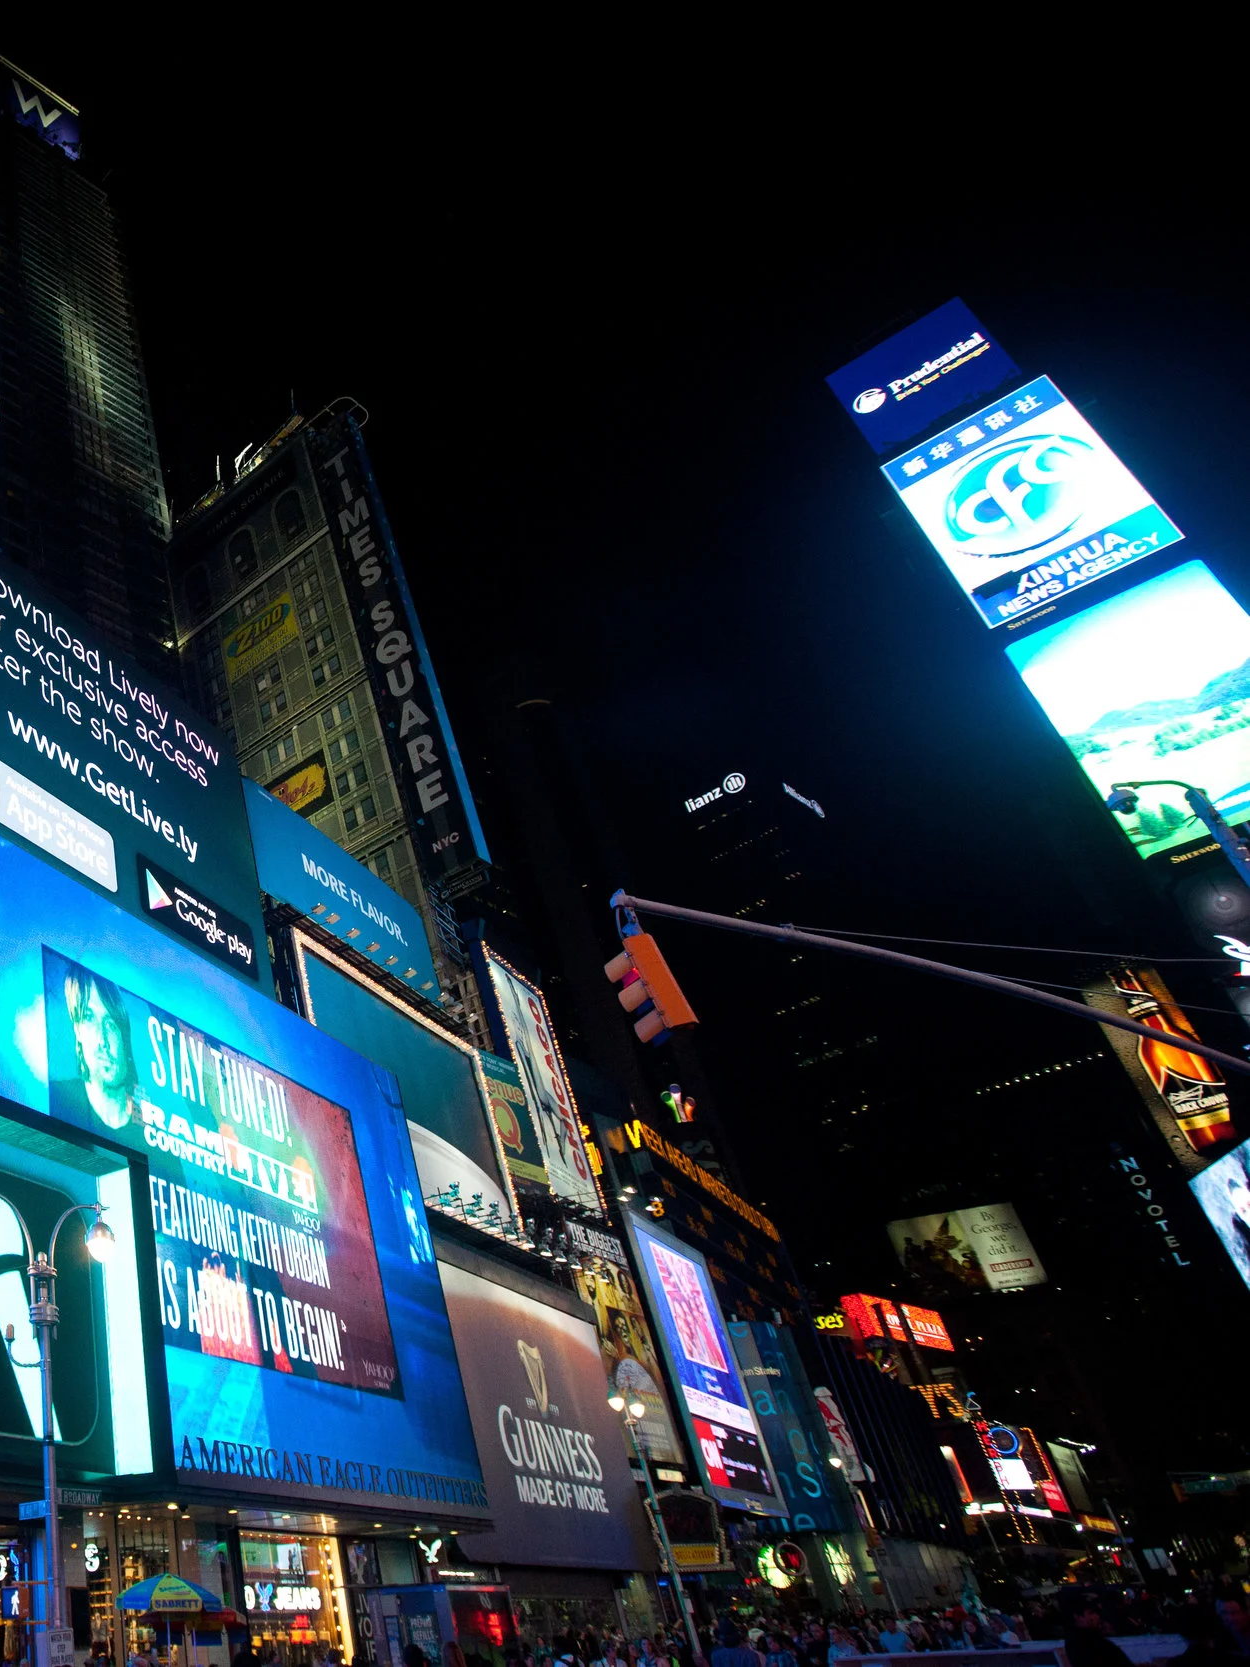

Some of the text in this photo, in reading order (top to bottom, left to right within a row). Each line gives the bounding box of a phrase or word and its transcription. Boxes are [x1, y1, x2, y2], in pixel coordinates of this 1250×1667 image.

[12, 78, 62, 128] W
[887, 332, 986, 395] Prudential
[323, 446, 382, 588] TIMES
[997, 531, 1160, 618] NEWS AGENCY
[1016, 533, 1129, 594] XINHUA
[15, 629, 128, 728] exclusive
[136, 718, 209, 788] access
[39, 676, 82, 726] the
[91, 715, 160, 784] show.
[109, 660, 169, 730] Lively
[175, 718, 220, 768] now
[369, 600, 450, 815] SQUARE
[7, 710, 198, 864] www.GetLive.ly
[7, 793, 109, 877] App Store
[432, 831, 461, 854] NYC
[1170, 842, 1222, 864] SHERWOO
[301, 852, 409, 947] MORE FLAVOR.
[175, 898, 252, 965] Google play
[147, 1014, 294, 1149] STAY TUNED!
[486, 1077, 525, 1106] enue
[527, 995, 589, 1182] CHICAGO
[139, 1098, 226, 1157] RAM
[143, 1125, 227, 1176] COUNTRY
[490, 1096, 524, 1153] Q
[148, 1173, 331, 1290] FEATURING KEITH URBAN
[292, 1209, 321, 1233] YAHOO!
[569, 1223, 589, 1245] THE
[586, 1228, 625, 1257] BIGGEST
[981, 1211, 996, 1222] By
[990, 1234, 1007, 1242] we
[1117, 1156, 1192, 1268] NOVOTEL
[988, 1244, 1007, 1256] did
[156, 1256, 346, 1372] IS ABOUT TO BEGIN!
[814, 1313, 844, 1330] se's
[361, 1358, 397, 1383] YAHOO!
[179, 1434, 491, 1510] AMERICAN EAGLE OUTFITTERS
[498, 1404, 603, 1482] GUINNESS
[63, 1490, 101, 1505] BROADWAY
[515, 1474, 557, 1506] MADE
[555, 1480, 573, 1508] OF
[273, 1585, 322, 1611] JEANS
